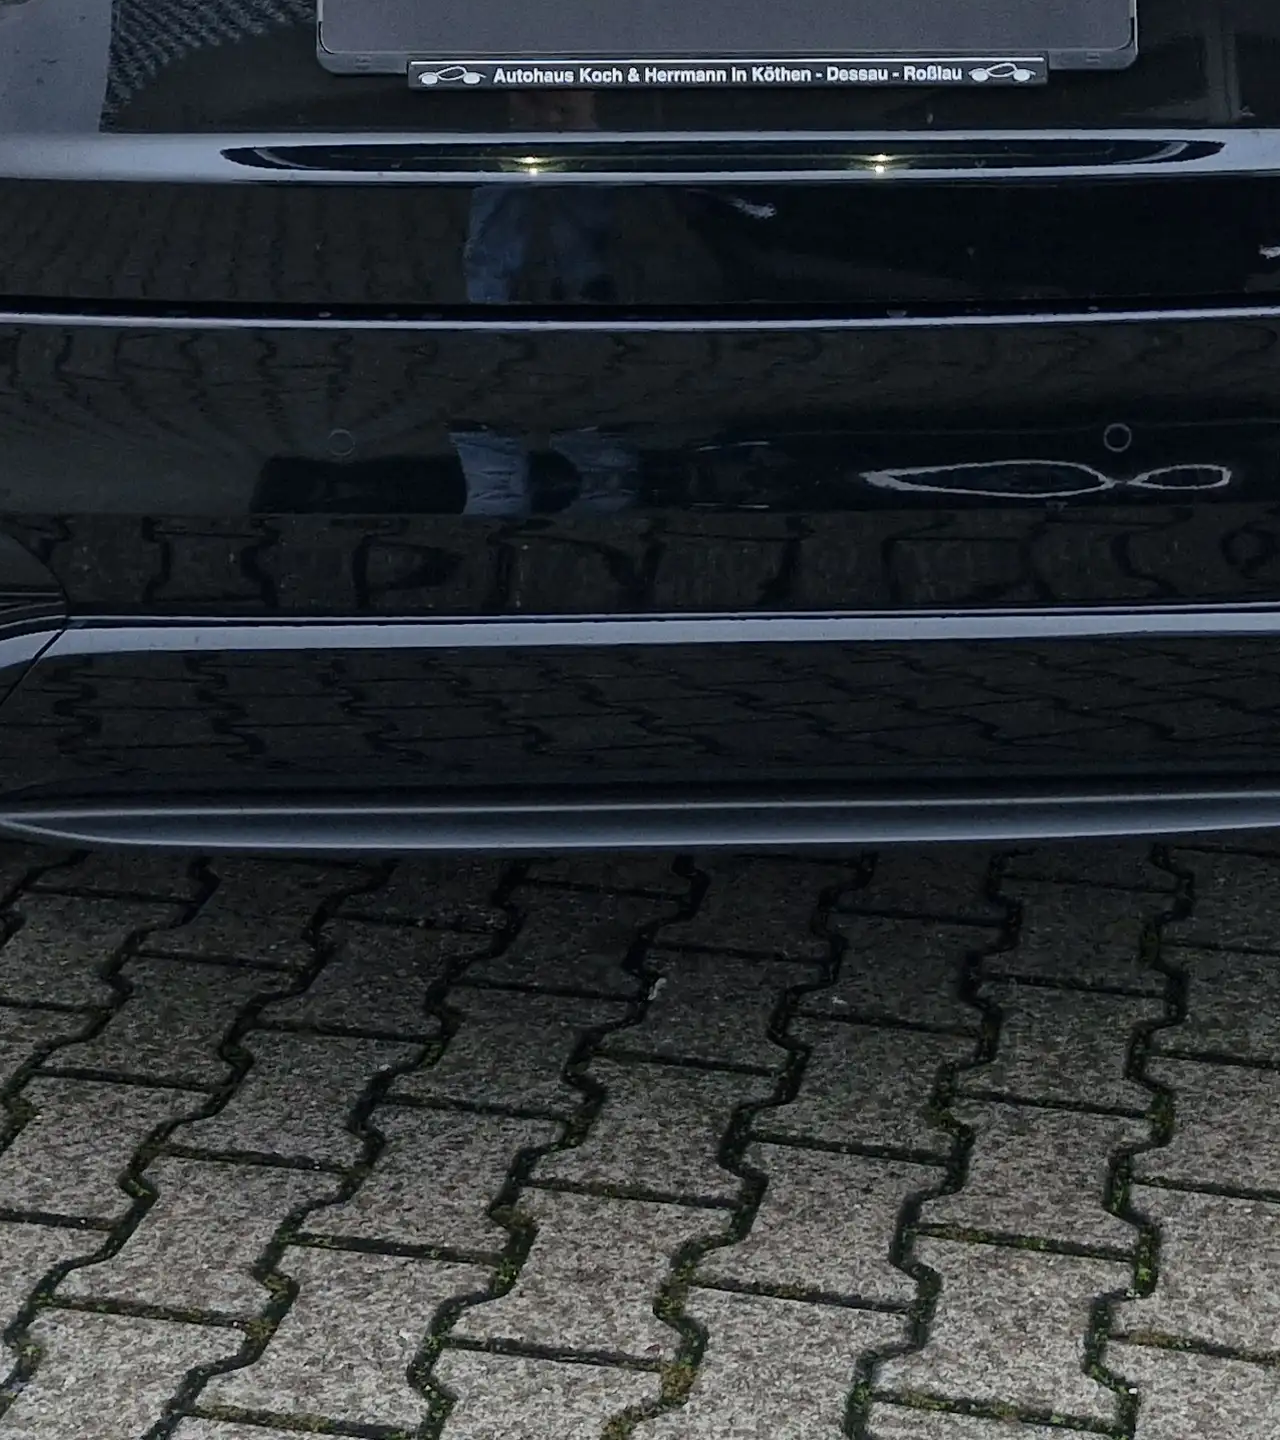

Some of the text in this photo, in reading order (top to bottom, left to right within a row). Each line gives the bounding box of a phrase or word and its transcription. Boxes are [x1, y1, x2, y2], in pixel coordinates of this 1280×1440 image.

[493, 66, 575, 84] Autohaus
[580, 66, 622, 83] Koch
[627, 67, 640, 83] &
[645, 65, 727, 83] Herrmann
[751, 65, 812, 83] Köthen
[827, 65, 888, 81] Dessau
[904, 64, 962, 81] Roßlau
